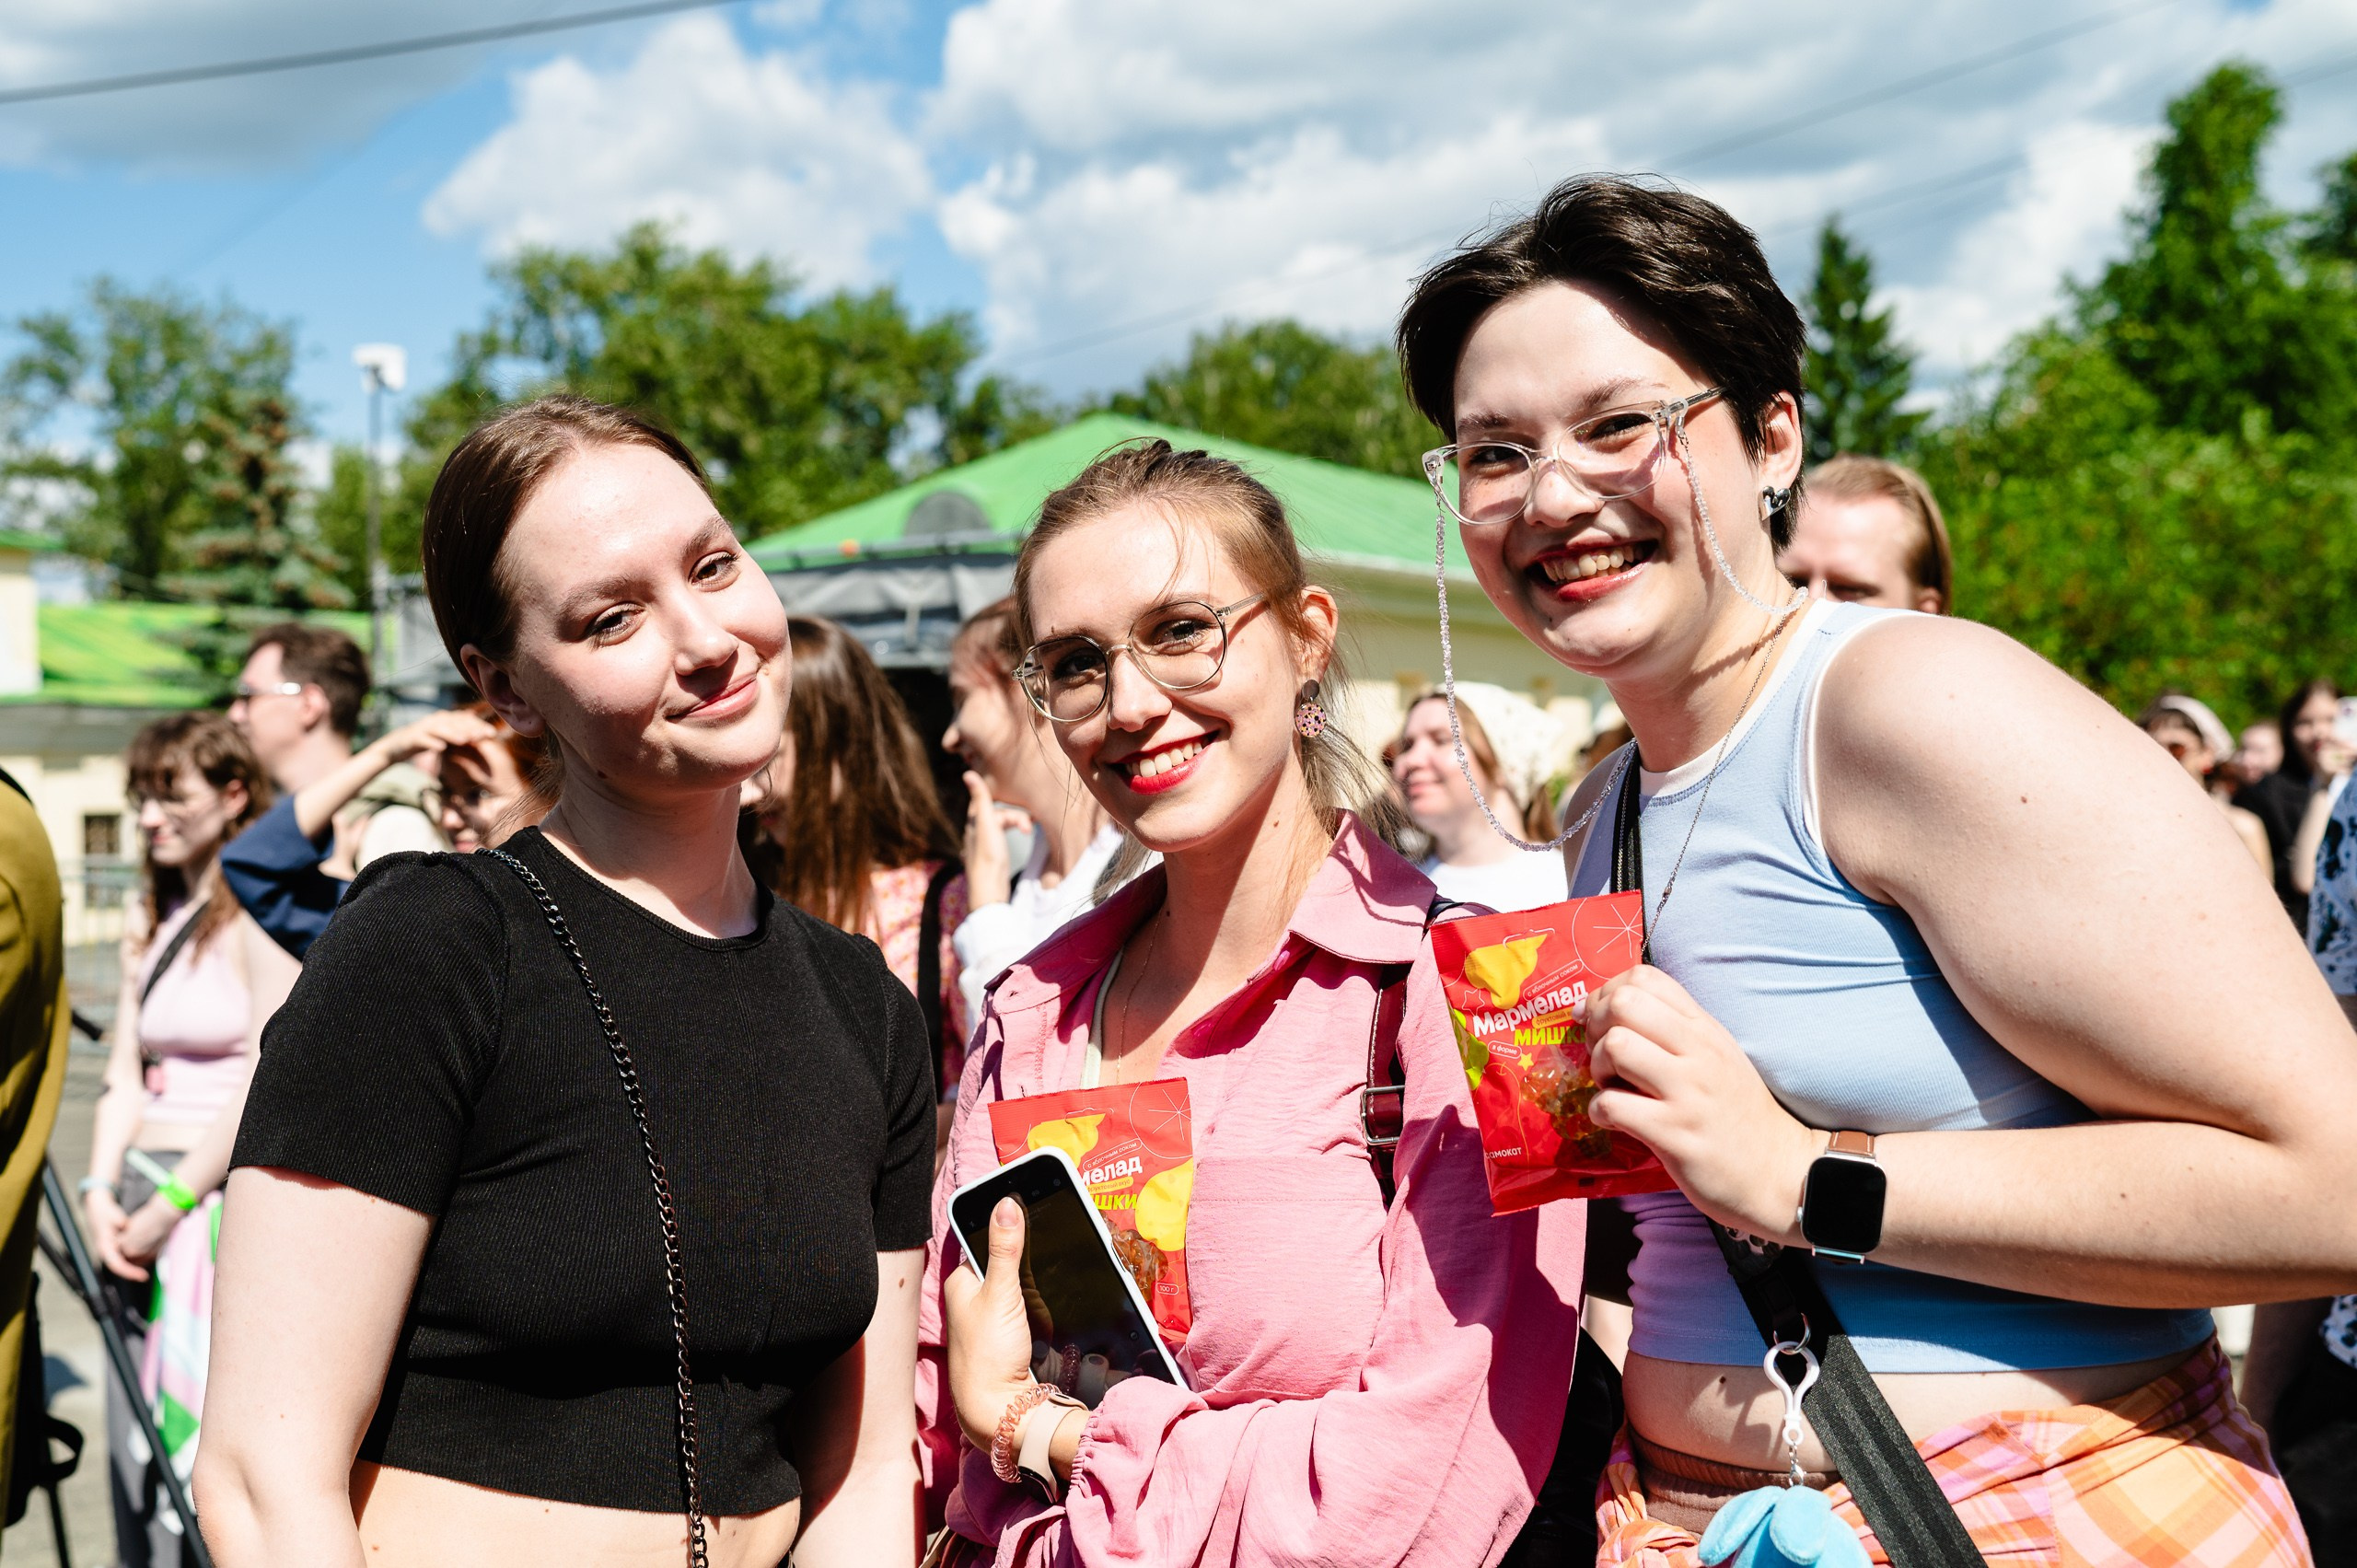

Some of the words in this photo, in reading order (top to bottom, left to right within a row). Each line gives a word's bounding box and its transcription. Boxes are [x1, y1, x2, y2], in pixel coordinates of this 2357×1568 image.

[1531, 974, 1560, 994] яблочным
[1560, 964, 1578, 978] соком
[1473, 980, 1588, 1038] Мармелад
[1497, 1044, 1518, 1055] форме
[1092, 1149, 1118, 1166] яблочным
[1119, 1142, 1137, 1153] соком
[1091, 1193, 1138, 1211] шки
